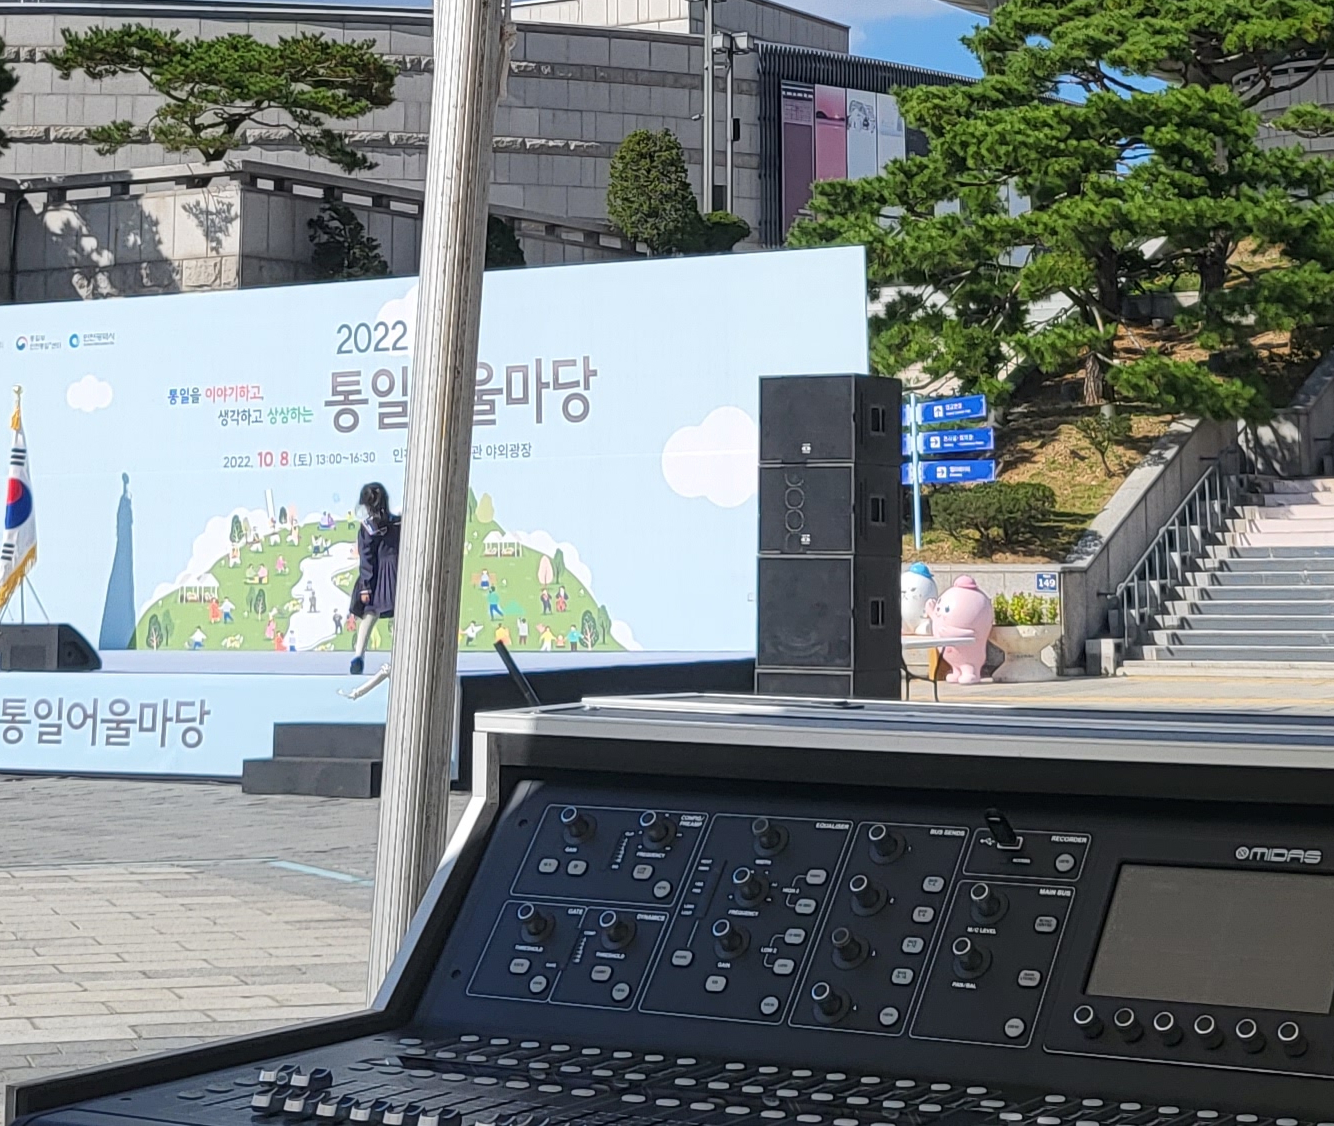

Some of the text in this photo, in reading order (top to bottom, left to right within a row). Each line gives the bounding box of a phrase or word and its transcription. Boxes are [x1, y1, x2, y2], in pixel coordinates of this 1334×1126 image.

[336, 319, 408, 354] 2022
[168, 384, 264, 405] 통일을 이야기하고,
[324, 355, 598, 434] 통일울마당
[218, 405, 314, 426] 생각하고 상상하는
[223, 455, 253, 469] 2022.
[316, 451, 376, 466] 13:00~16:30
[485, 442, 532, 460] 야외광장
[1038, 578, 1055, 587] 149
[816, 822, 850, 830] EQUALISER
[1051, 835, 1087, 843] RECORDER
[1249, 847, 1322, 864] MIDAS
[1039, 888, 1057, 896] MAIN
